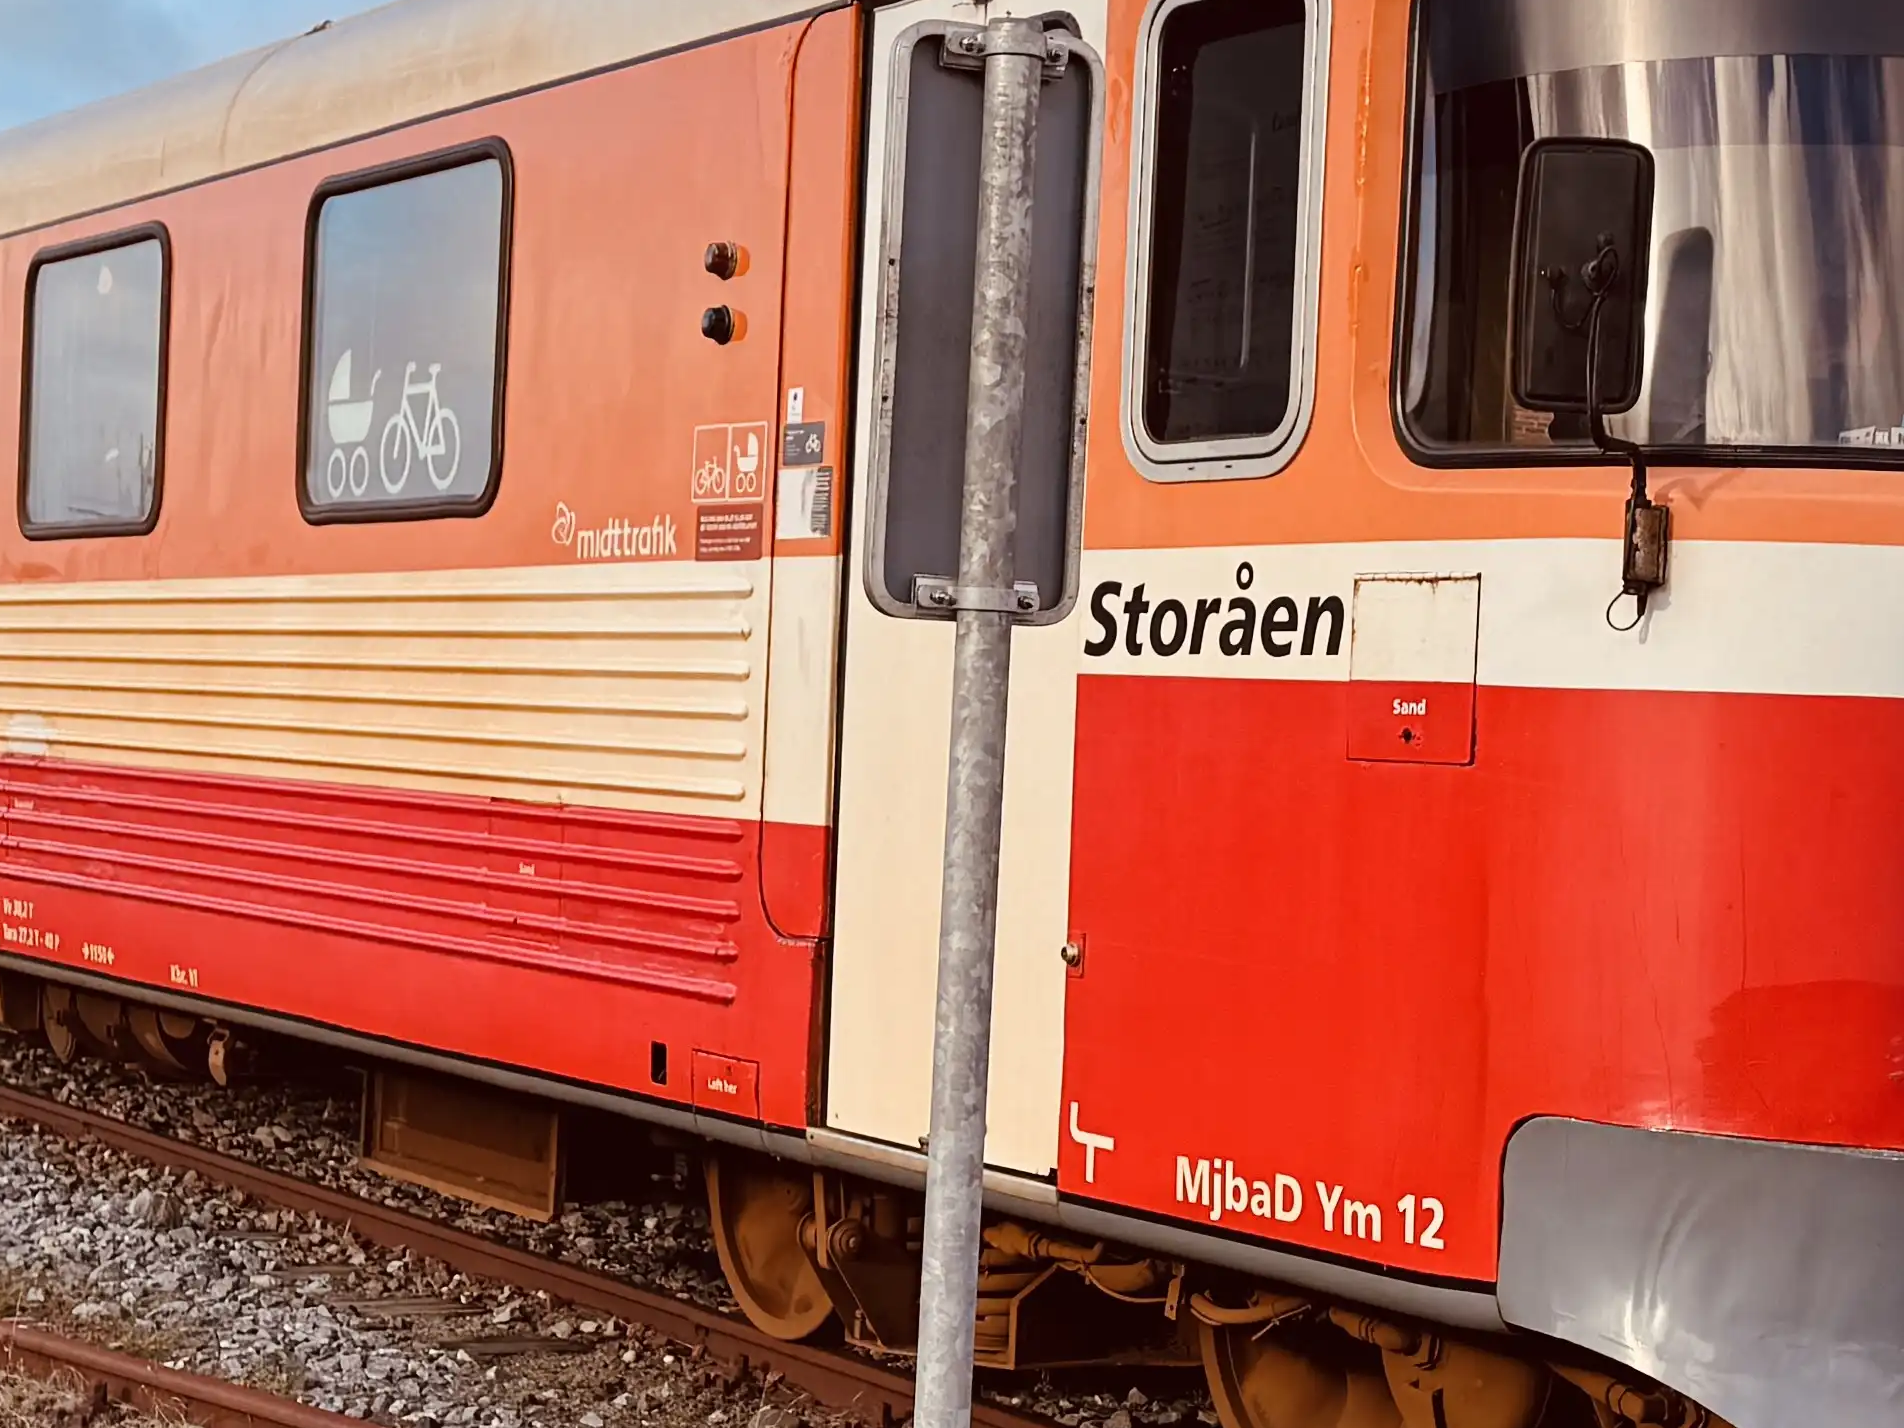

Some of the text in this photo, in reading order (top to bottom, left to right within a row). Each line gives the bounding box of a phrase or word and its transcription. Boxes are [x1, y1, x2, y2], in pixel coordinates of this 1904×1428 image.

[576, 513, 678, 560] midttrafik
[1083, 560, 1346, 658] Storåen
[1392, 698, 1427, 716] Sand
[1175, 1154, 1446, 1250] MjbaD Ym 12
